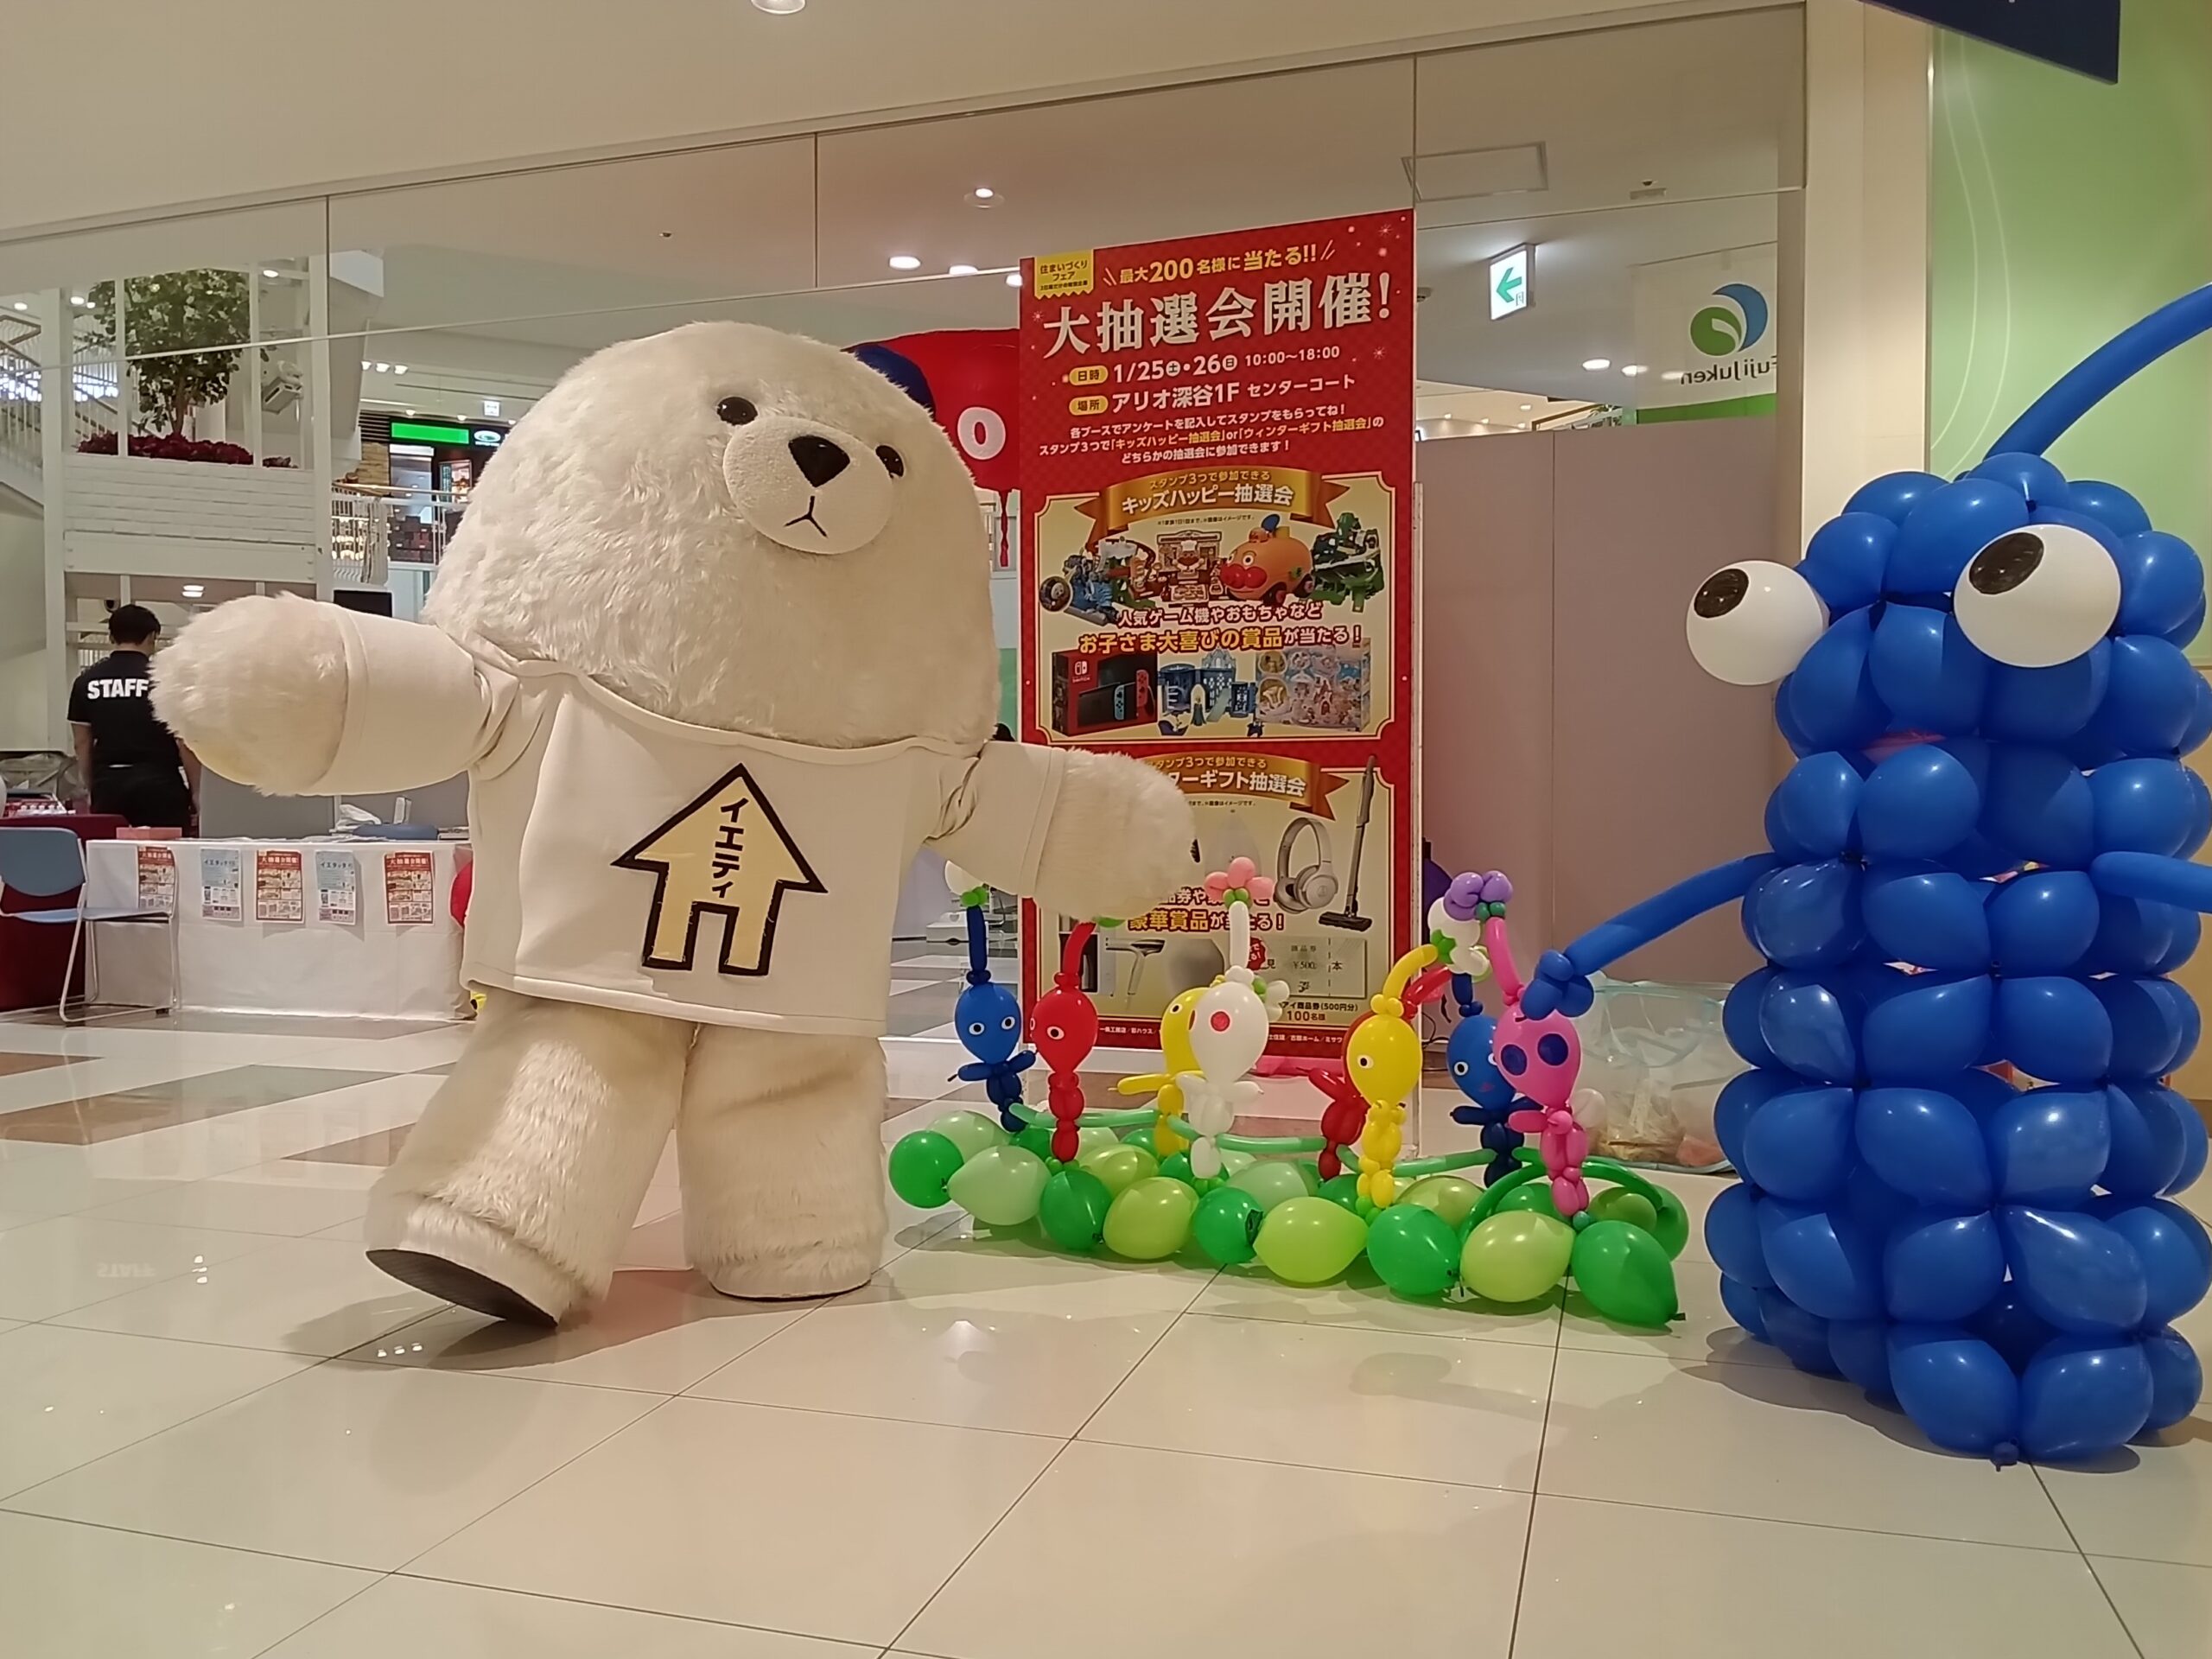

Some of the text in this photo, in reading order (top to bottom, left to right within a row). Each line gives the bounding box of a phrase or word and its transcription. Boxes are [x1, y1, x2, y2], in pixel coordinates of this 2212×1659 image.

[1039, 260, 1088, 274] 住まいづくり
[1052, 271, 1075, 282] フェア
[1077, 370, 1100, 381] 日時
[1077, 374, 1355, 412] 場所 アリオ深谷1F センターコート
[1122, 483, 1294, 514] キッズハッピー抽選会
[1118, 602, 1322, 626] 人気ゲーム機やおもちゃなど
[87, 678, 149, 699] STAFF
[712, 798, 749, 898] イエティ
[1129, 910, 1283, 931] 豪華賞品がる！
